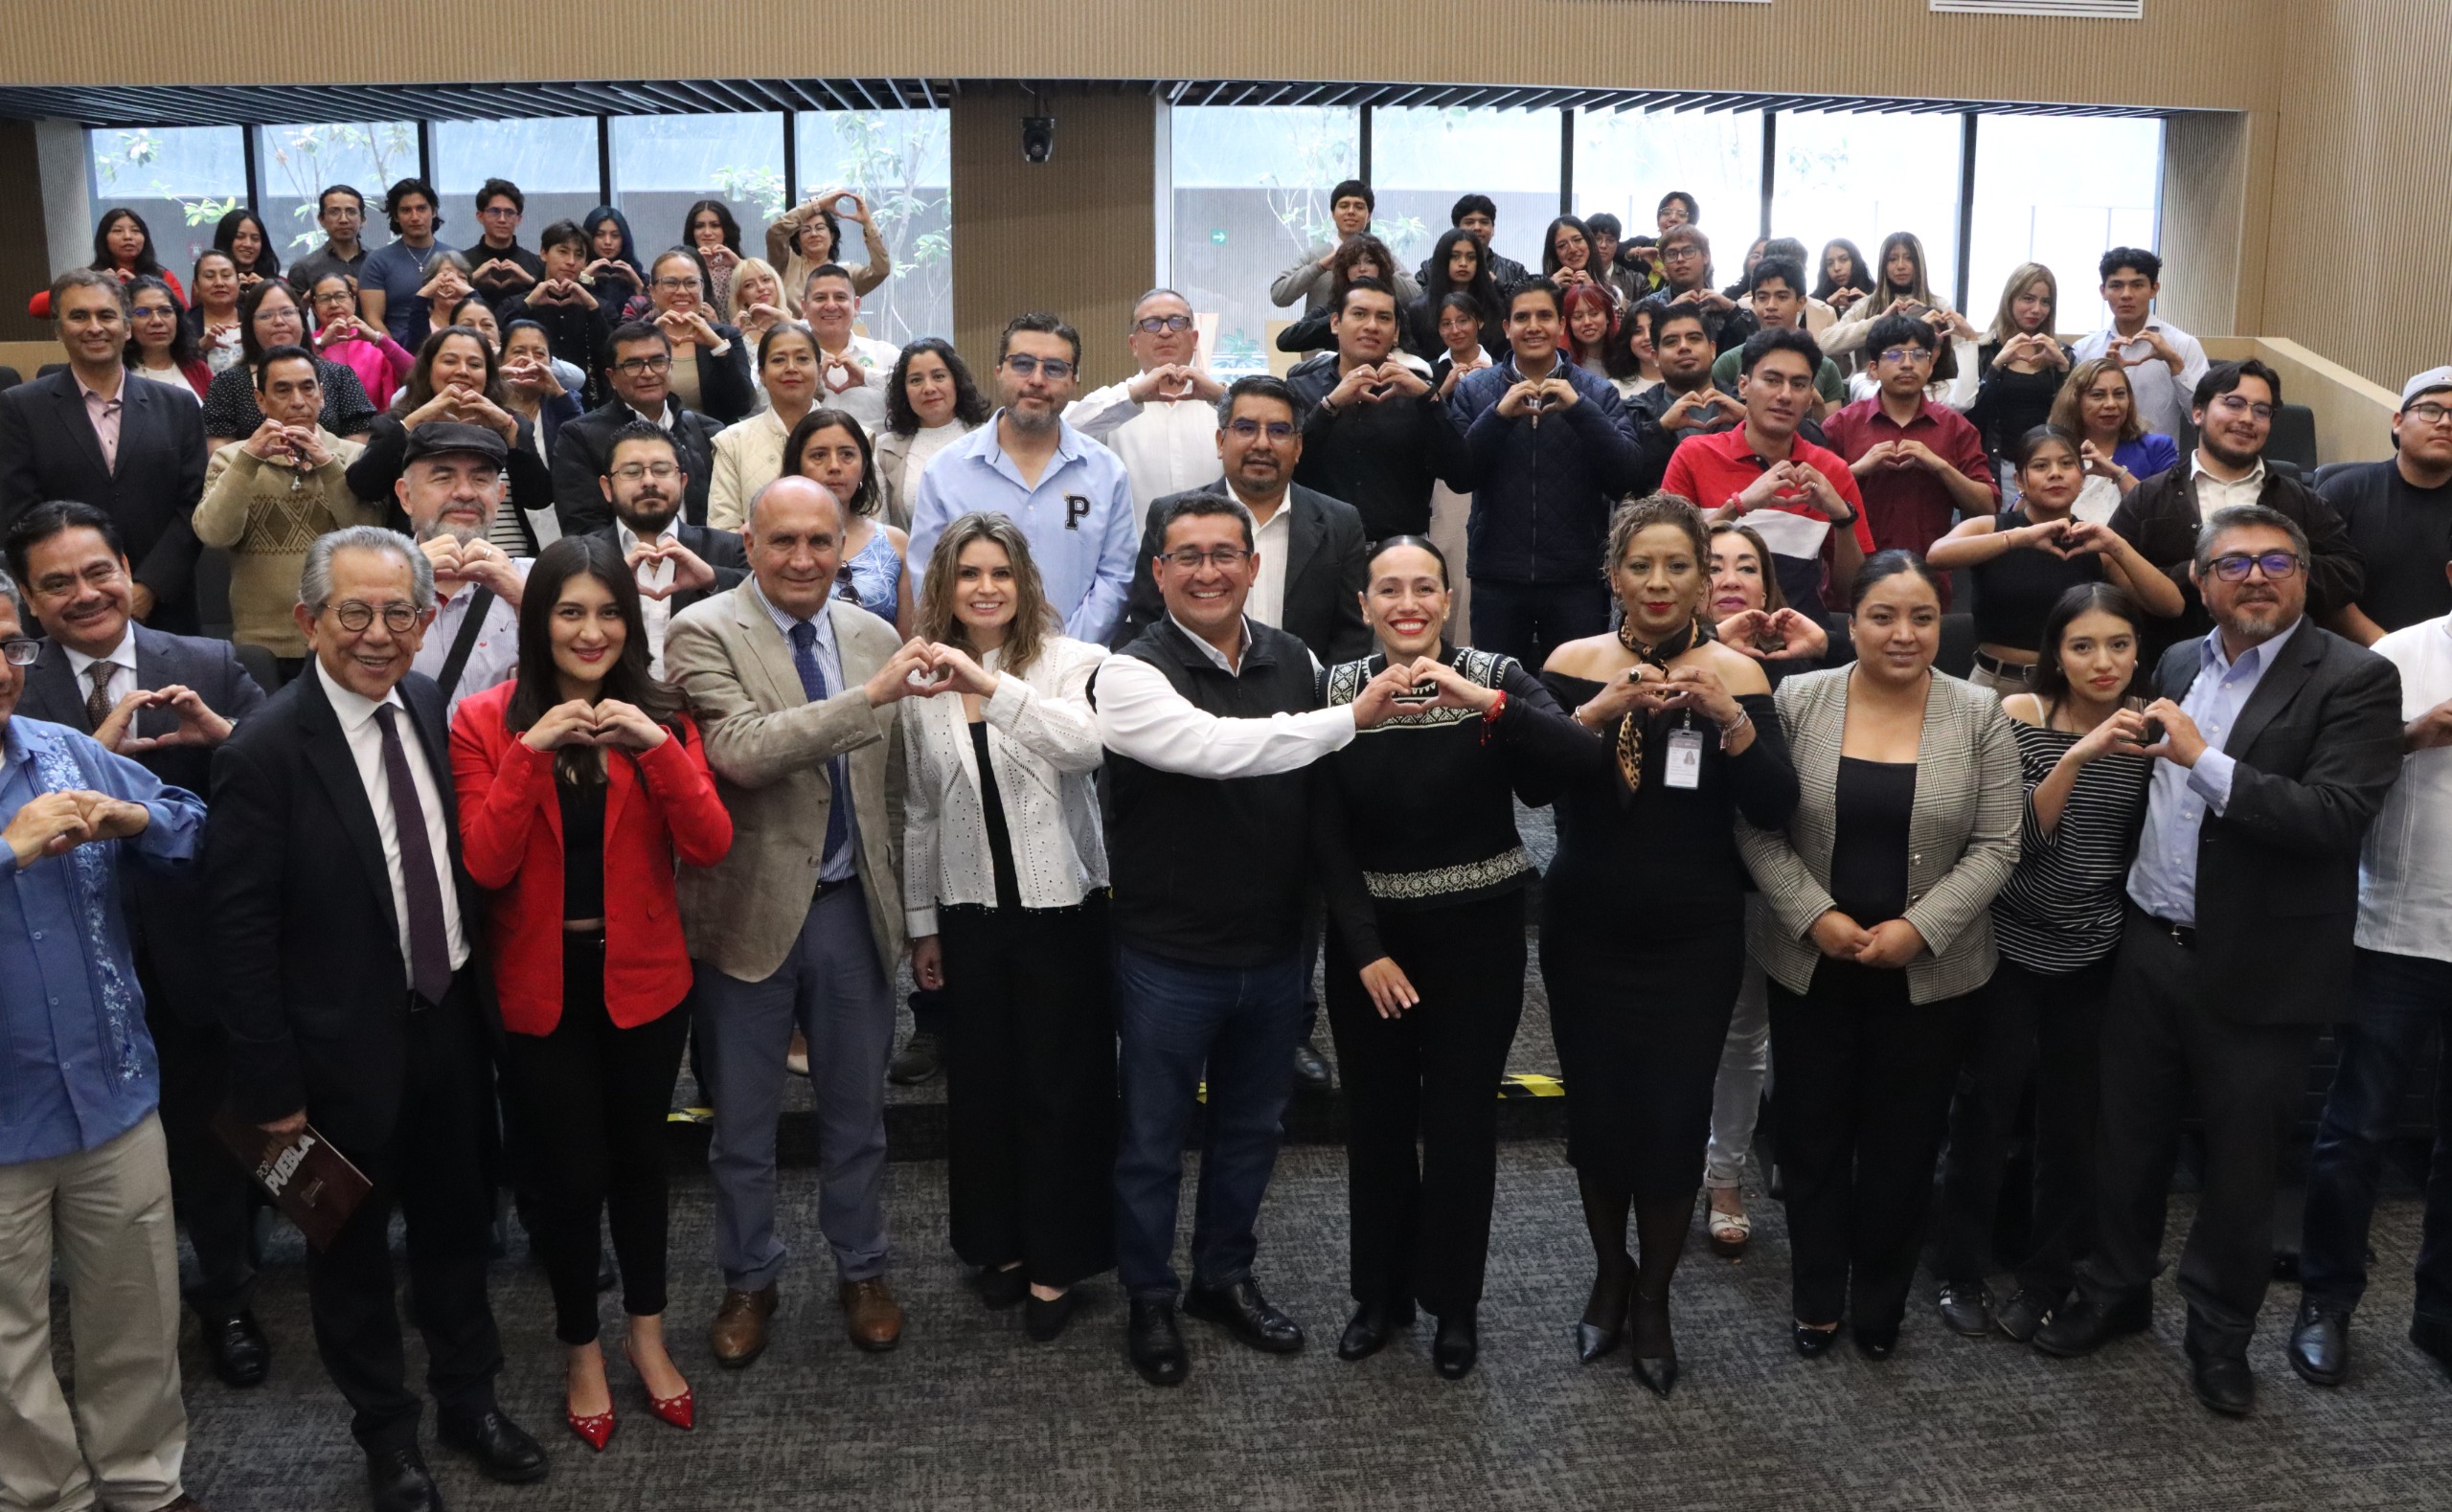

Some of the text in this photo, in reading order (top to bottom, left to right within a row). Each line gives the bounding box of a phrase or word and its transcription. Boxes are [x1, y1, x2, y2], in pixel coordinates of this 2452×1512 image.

[1064, 494, 1090, 530] P
[256, 1160, 272, 1180] POR
[264, 1134, 316, 1197] PUEBLA
